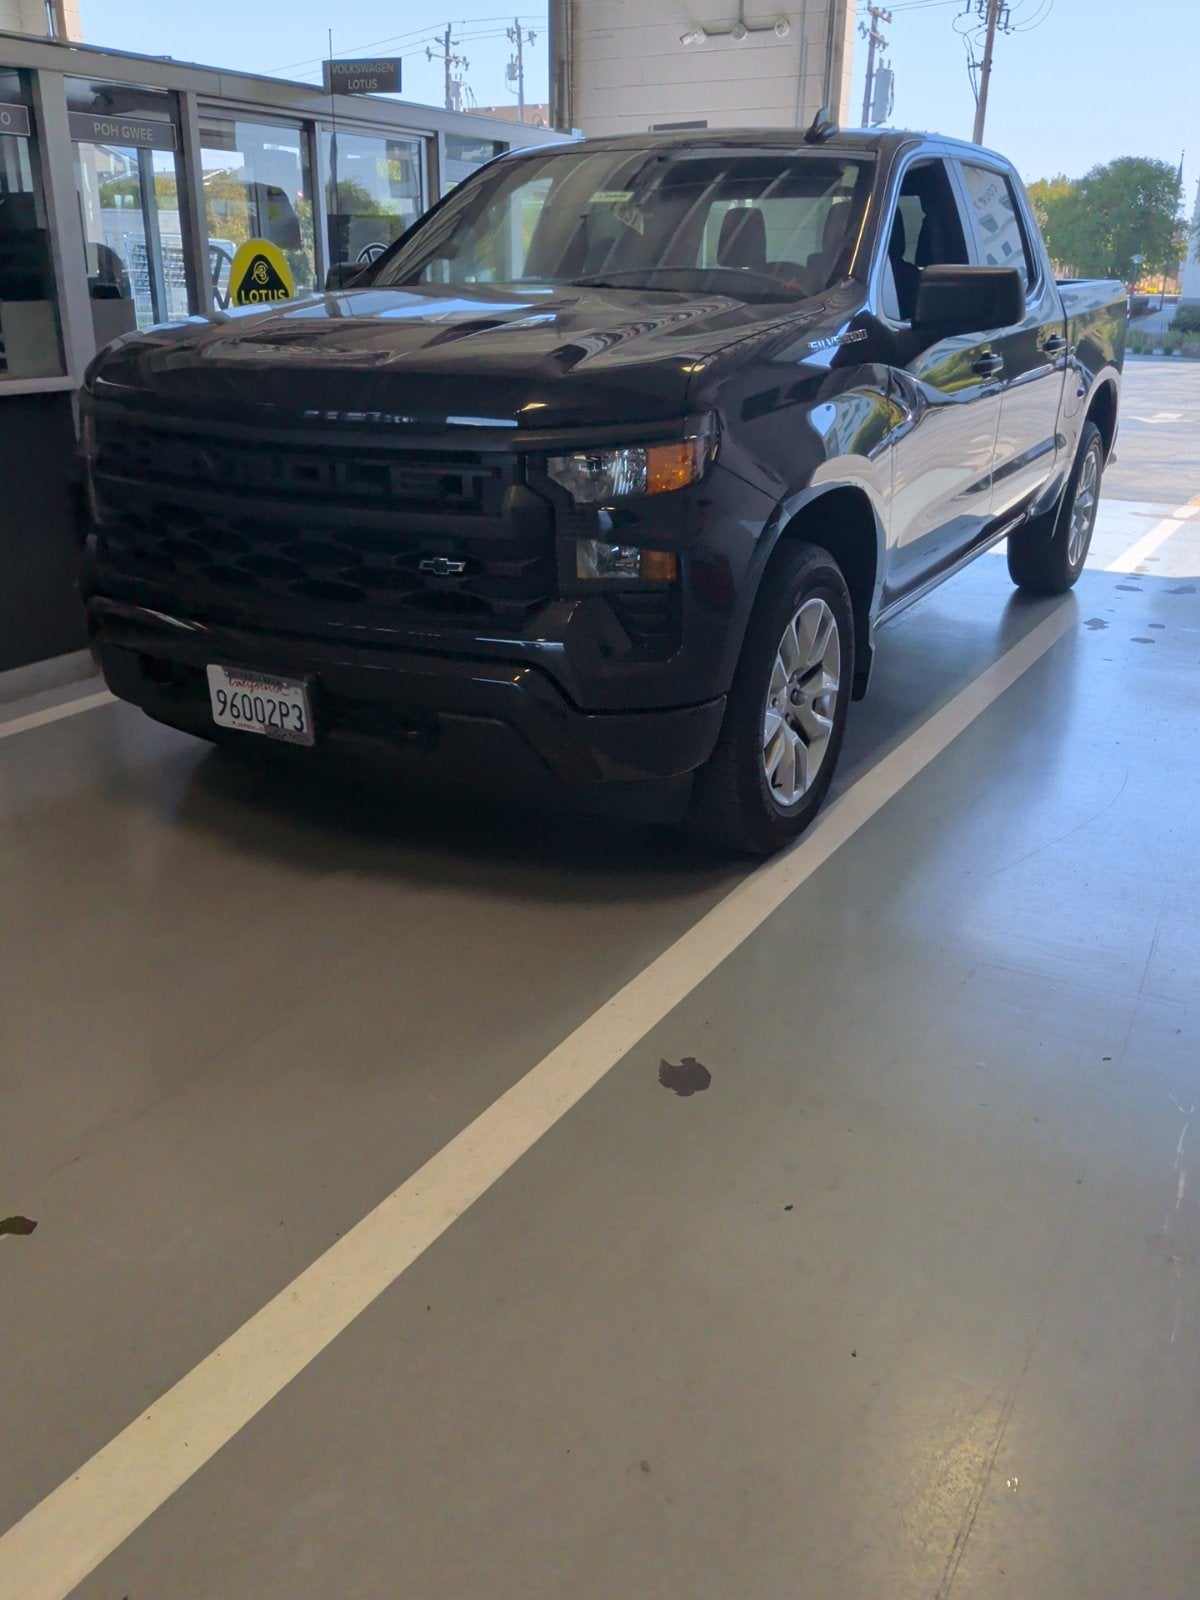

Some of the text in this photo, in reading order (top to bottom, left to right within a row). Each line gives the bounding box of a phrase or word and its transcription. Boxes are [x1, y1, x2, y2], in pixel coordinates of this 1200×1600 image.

[331, 63, 395, 74] VOLKSWAGEN
[348, 79, 378, 90] LOTUS
[93, 122, 154, 141] POH GWEE
[241, 289, 286, 304] LOTUS
[216, 689, 305, 733] 96002P3
